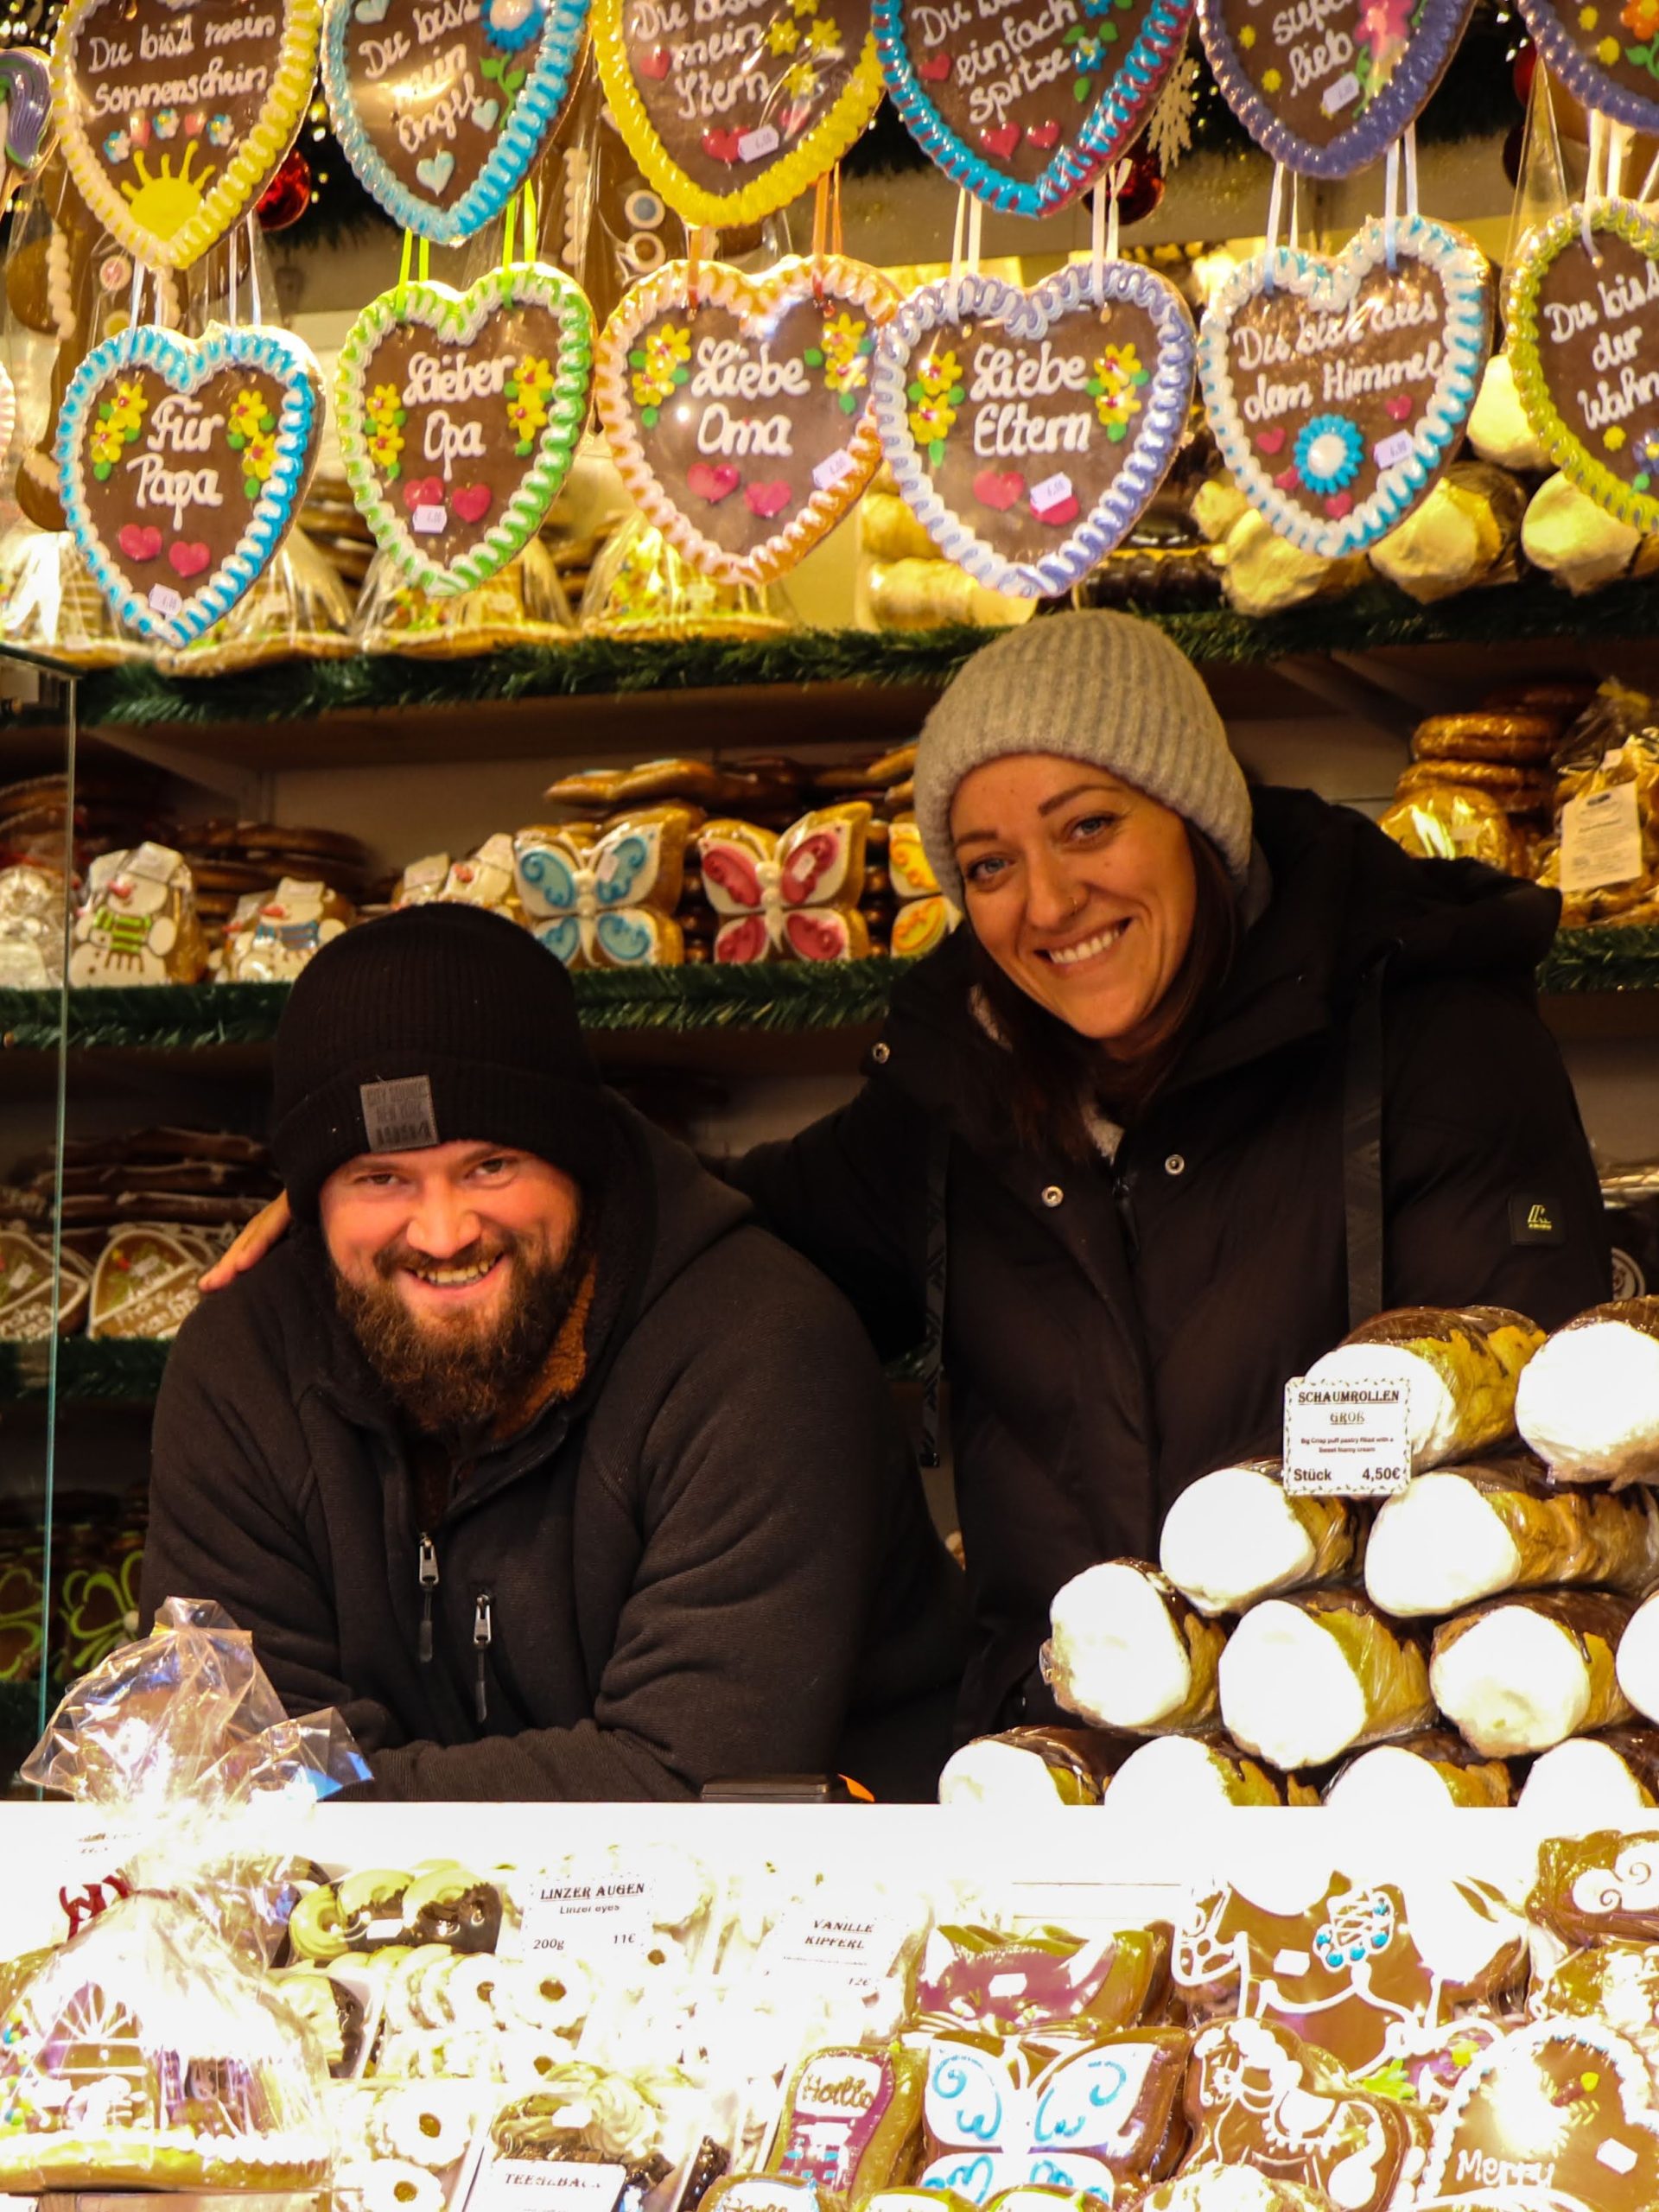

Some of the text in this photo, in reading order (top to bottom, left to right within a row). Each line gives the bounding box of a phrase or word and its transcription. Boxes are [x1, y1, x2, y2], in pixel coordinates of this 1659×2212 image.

[88, 3, 276, 73] Du bist mein
[633, 2, 690, 41] Du
[671, 21, 766, 72] mein
[911, 0, 972, 47] Du
[956, 0, 1077, 86] einfach
[359, 30, 411, 79] Du
[1288, 29, 1354, 97] lieb
[1233, 326, 1291, 371] Du
[1370, 290, 1438, 334] aus
[1544, 302, 1598, 343] Du
[691, 335, 811, 401] Liebe
[969, 340, 1090, 401] Liebe
[1592, 326, 1642, 371] der
[402, 352, 517, 408] Lieber
[1243, 340, 1444, 423] dem Himmel
[423, 410, 486, 482] Opa
[697, 402, 793, 457] Oma
[974, 401, 1092, 457] Eltern
[126, 452, 224, 531] Papa
[1298, 1390, 1400, 1403] SCHAUMROLLEN
[1294, 1467, 1401, 1481] Stück 4,50€
[540, 1883, 645, 1900] LINZER AUGEN
[560, 1904, 620, 1915] Linzer eyes
[533, 1937, 565, 1951] 200g
[804, 1935, 865, 1950] KIPFERL
[813, 1918, 874, 1933] VANILLE
[1456, 2148, 1555, 2189] Merry
